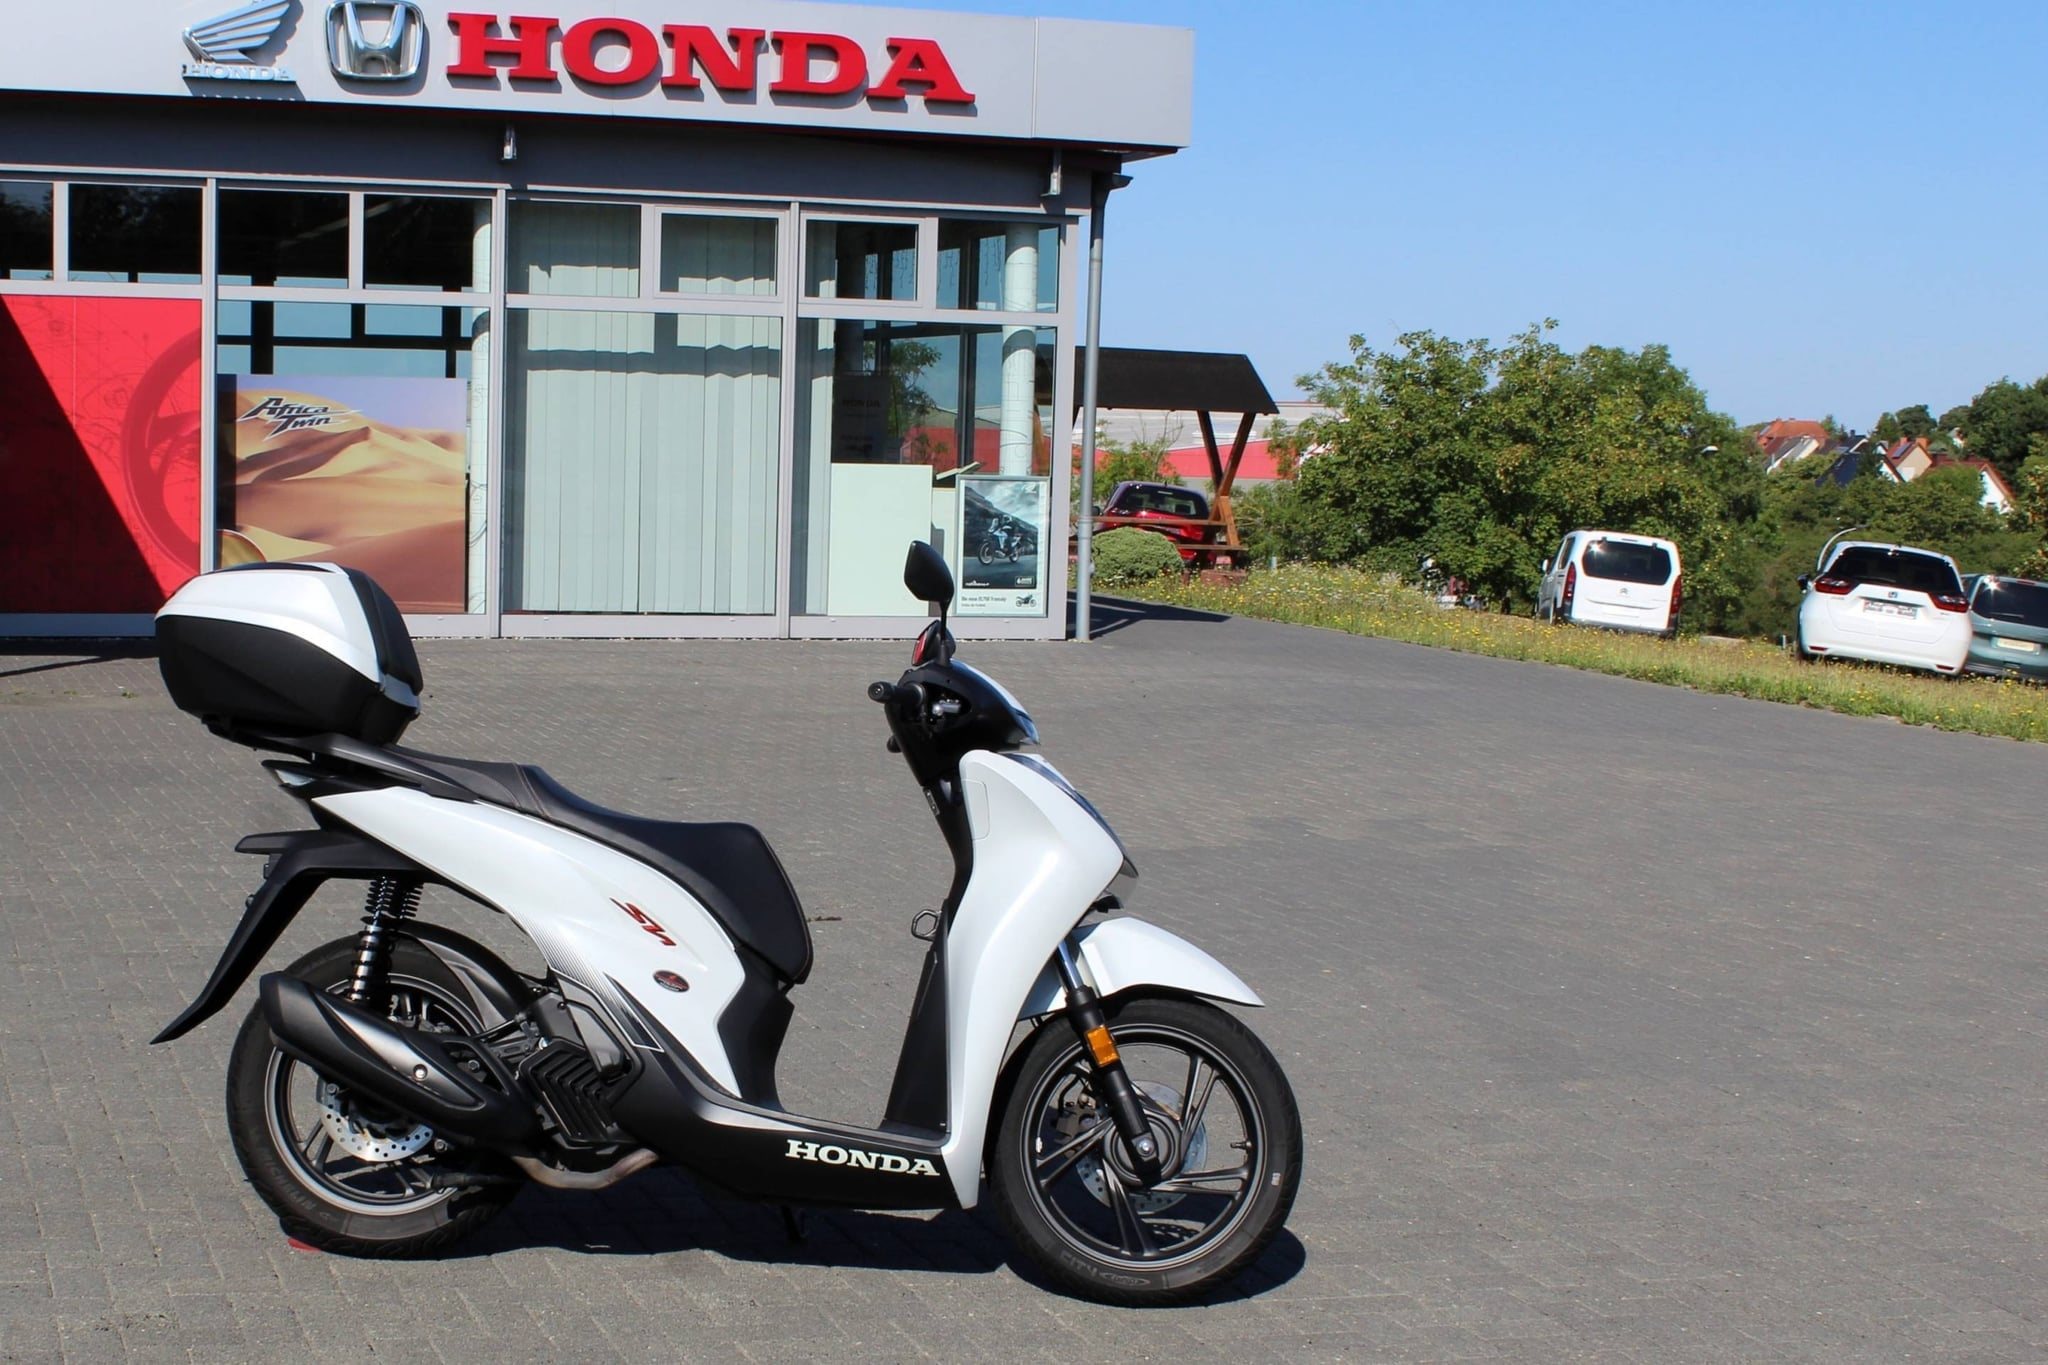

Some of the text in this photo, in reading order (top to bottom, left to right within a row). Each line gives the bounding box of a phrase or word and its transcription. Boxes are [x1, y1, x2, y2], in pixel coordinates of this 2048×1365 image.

[446, 12, 976, 104] HONDA
[182, 64, 297, 81] HONDA
[238, 396, 338, 420] Africa
[265, 414, 334, 439] Twin
[785, 1139, 941, 1176] HONDA
